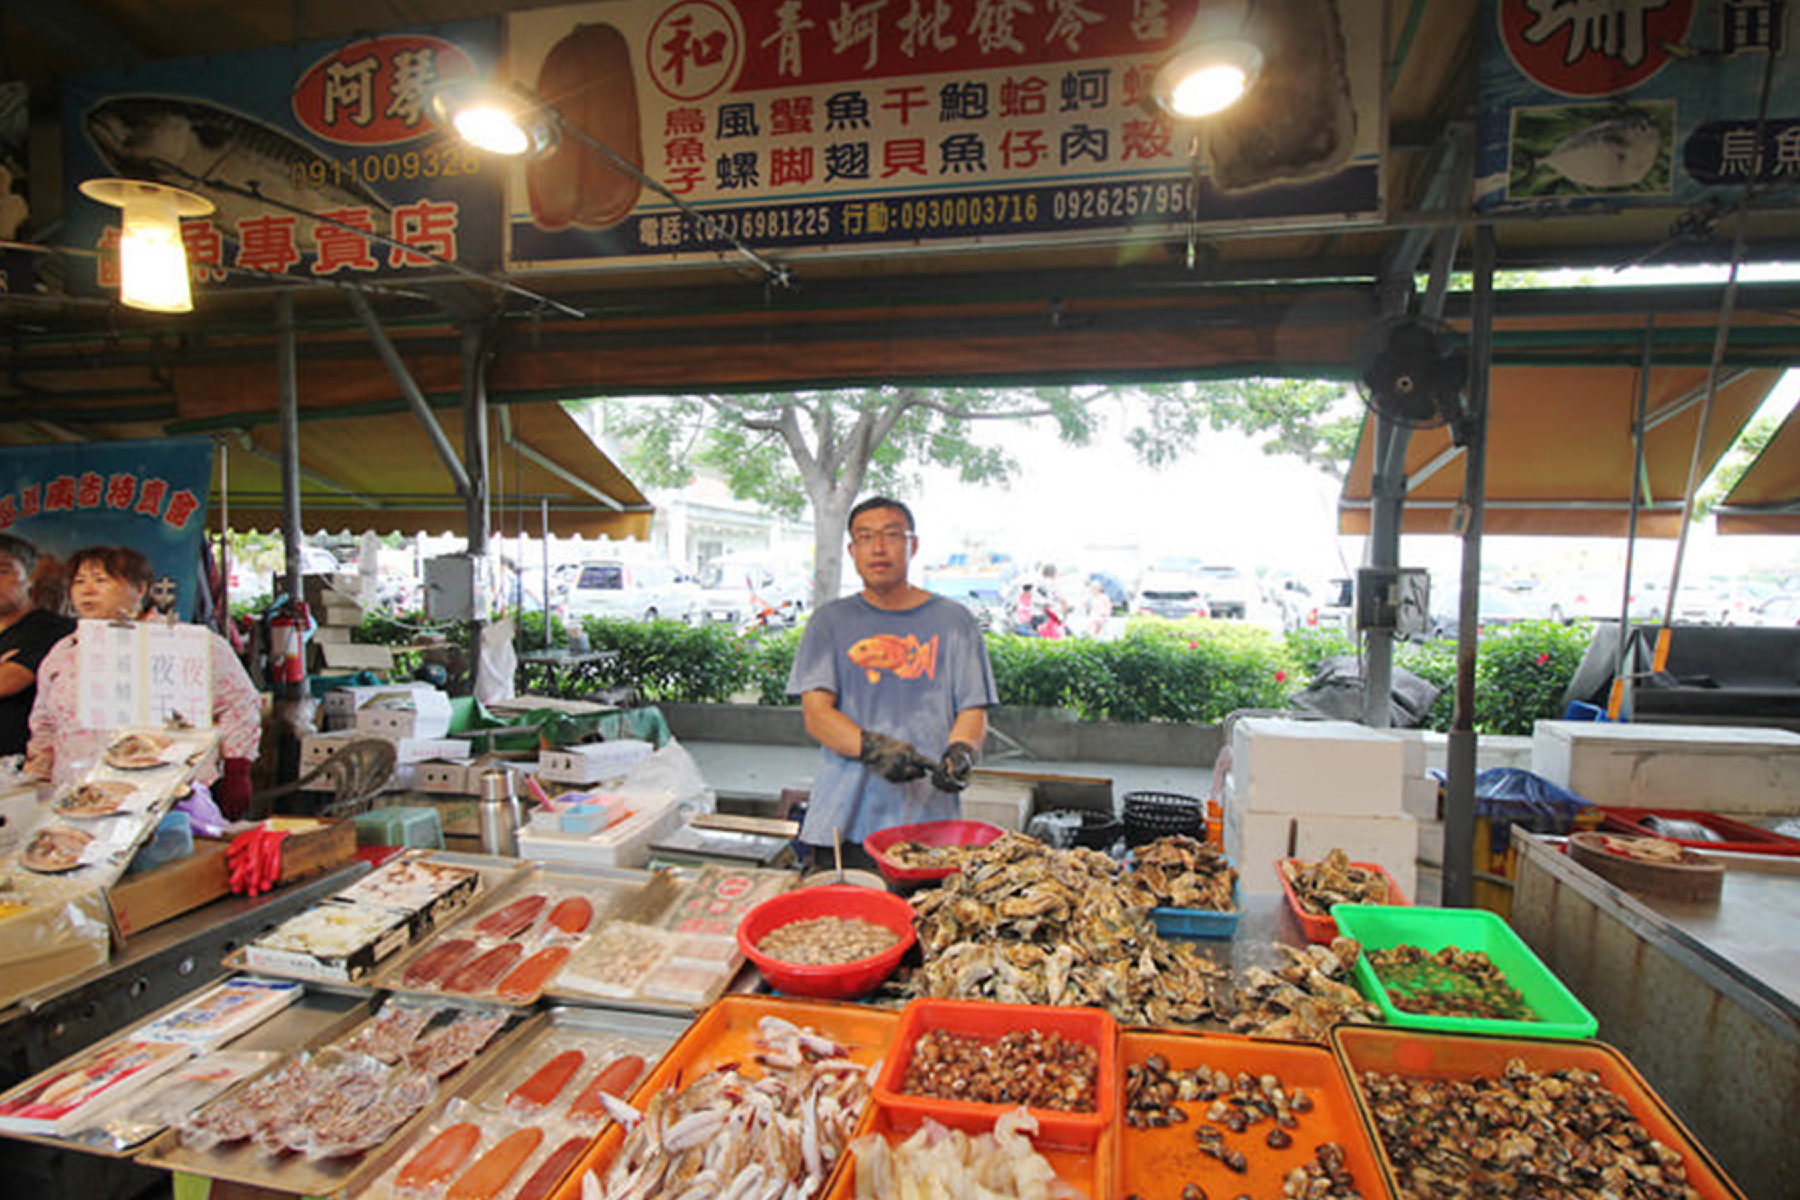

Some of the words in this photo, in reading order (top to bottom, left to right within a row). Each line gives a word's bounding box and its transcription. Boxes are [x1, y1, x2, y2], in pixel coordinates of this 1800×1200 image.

[661, 14, 728, 88] 和
[715, 103, 760, 190] 風螺
[824, 90, 870, 182] 魚翅
[880, 86, 930, 178] 干貝
[939, 81, 988, 174] 鮑魚
[998, 76, 1048, 170] 蛤仔
[1059, 68, 1111, 165] 蚵肉
